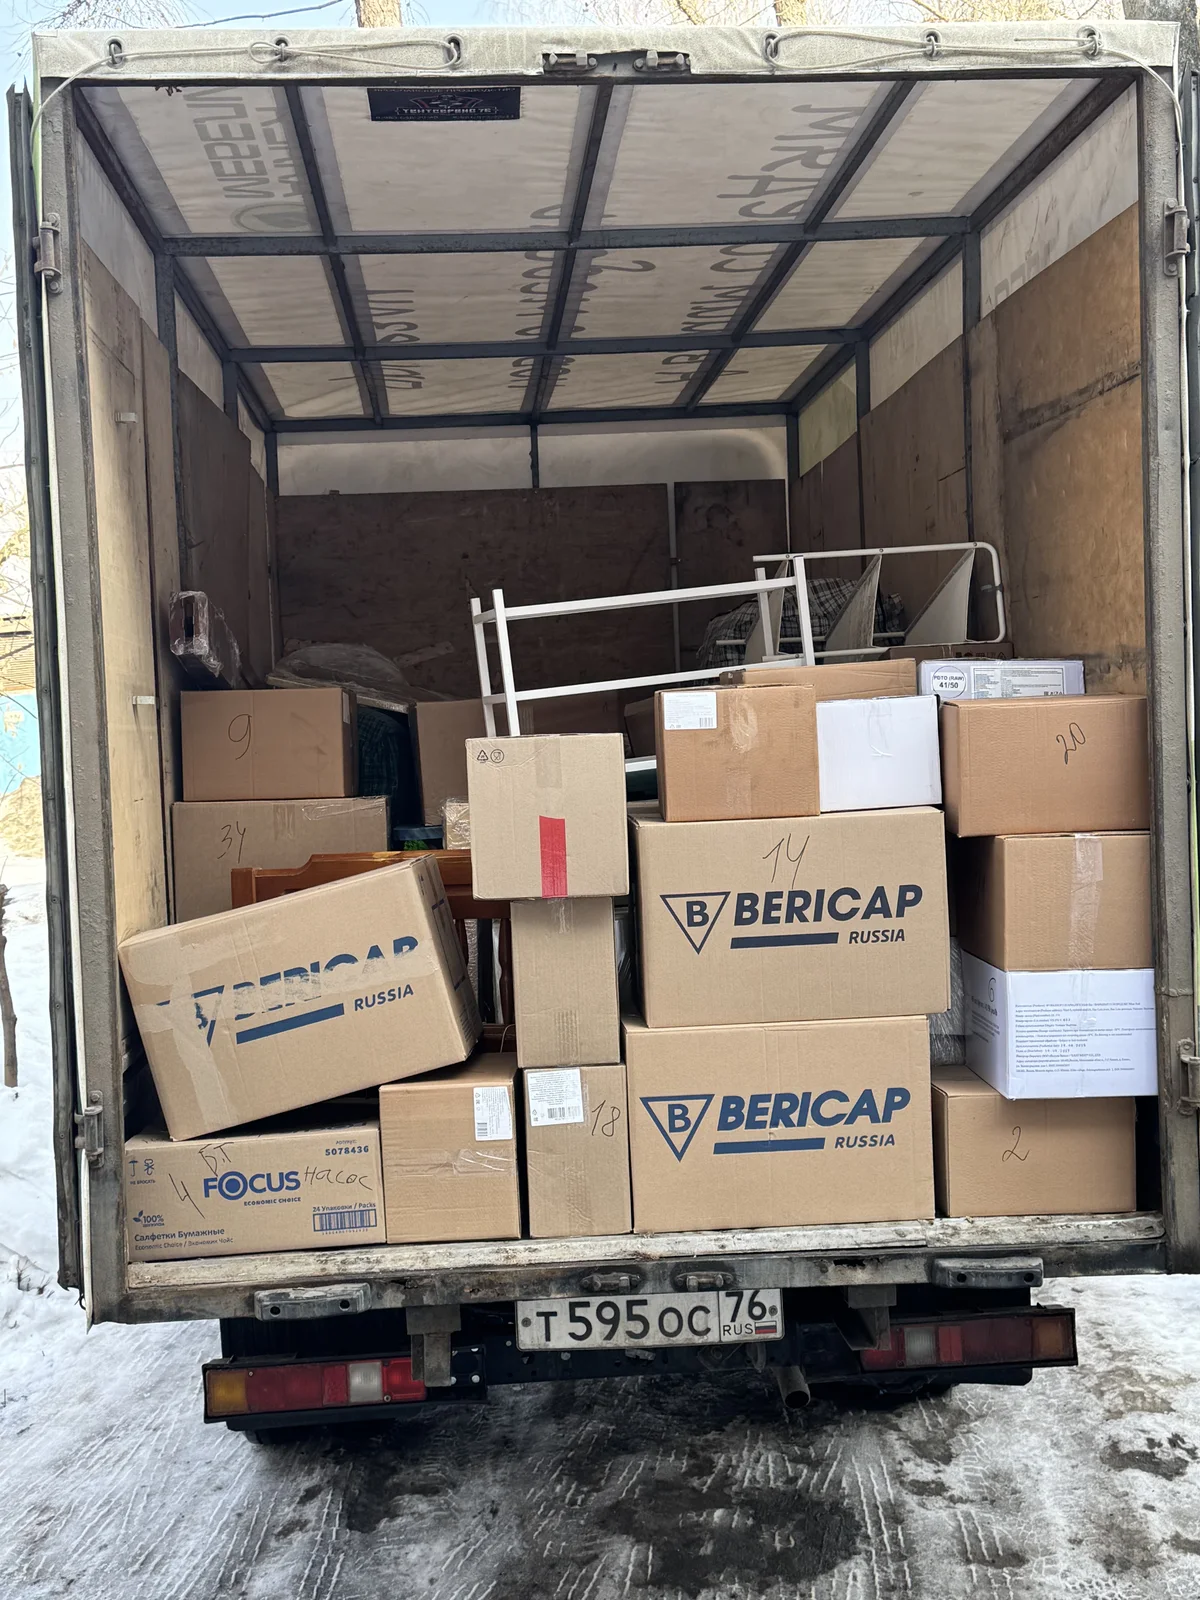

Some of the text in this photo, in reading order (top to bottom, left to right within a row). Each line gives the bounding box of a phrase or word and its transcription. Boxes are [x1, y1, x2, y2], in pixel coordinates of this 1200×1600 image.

[228, 713, 252, 760] 9
[1056, 722, 1086, 765] 20
[762, 833, 810, 890] 14
[734, 884, 924, 926] BERICAP
[848, 929, 906, 945] RUSSIA
[353, 983, 414, 1012] RUSSIA
[988, 977, 997, 1003] 6
[591, 1099, 621, 1138] 18
[717, 1087, 911, 1131] BERICAP
[325, 1145, 369, 1156] 5078436
[834, 1134, 896, 1149] RUSSIA
[1001, 1125, 1031, 1163] 2
[203, 1170, 301, 1201] FOCUS
[243, 1196, 302, 1207] ECONOMIC CHOICE
[358, 1201, 377, 1209] Packs
[142, 1214, 165, 1224] 100%
[134, 1228, 226, 1242] Салфетки Бумажные
[725, 1289, 768, 1323] 76
[722, 1323, 755, 1337] RUS
